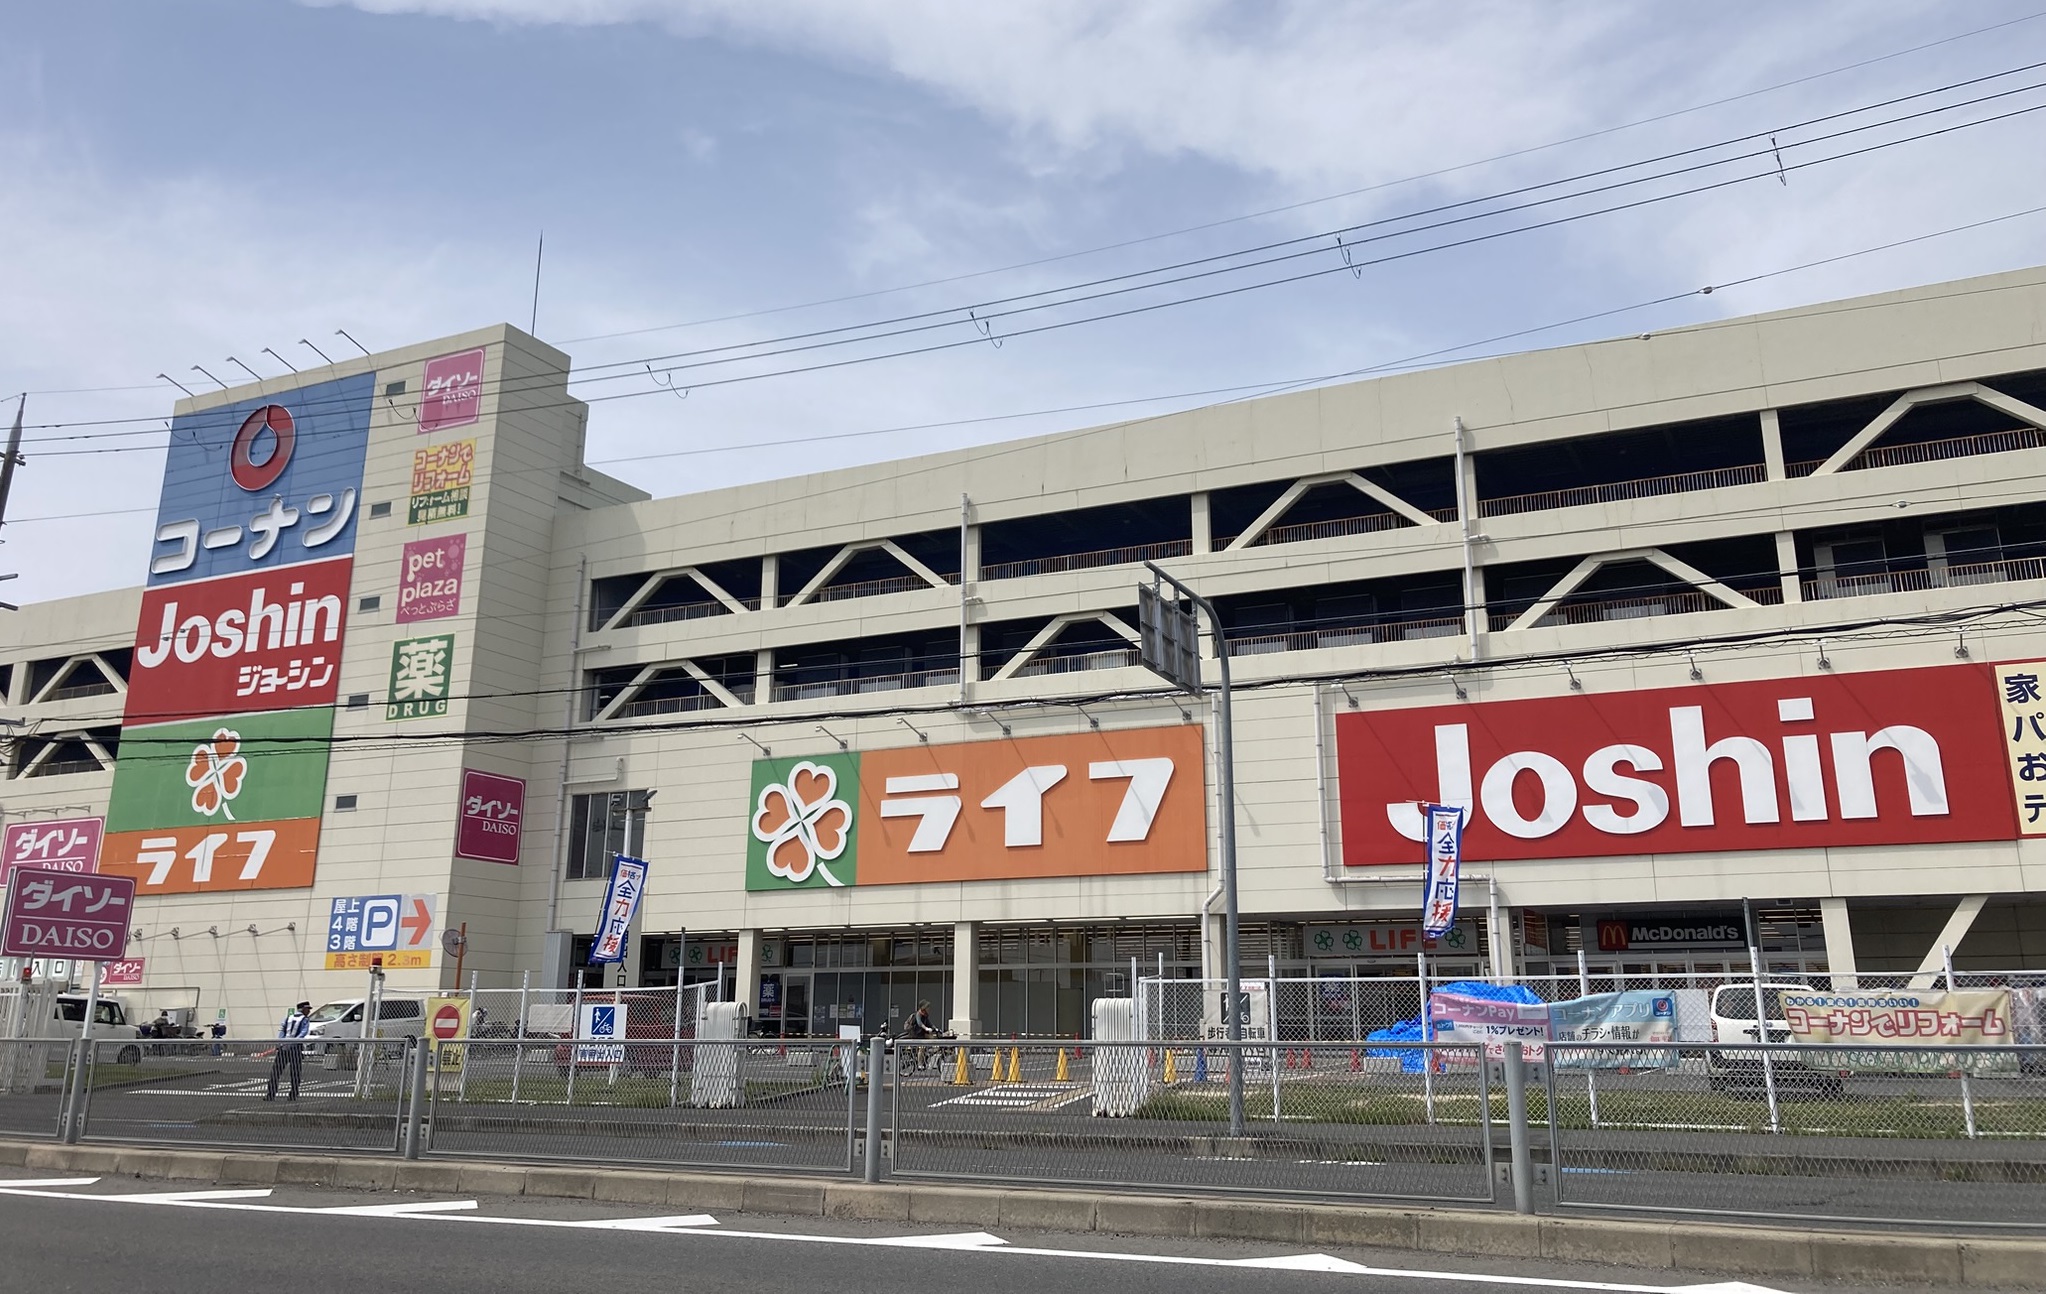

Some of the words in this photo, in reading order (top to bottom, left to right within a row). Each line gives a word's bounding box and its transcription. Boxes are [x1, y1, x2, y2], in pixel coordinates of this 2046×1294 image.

[427, 371, 478, 396] ダイソー
[442, 389, 477, 405] DAISO
[415, 443, 474, 471] コーナンで
[412, 464, 471, 494] リフォーム
[150, 486, 356, 575] コーナン
[406, 548, 446, 583] pet
[400, 578, 458, 606] plaza
[137, 581, 342, 669] Joshin
[236, 656, 334, 697] ジョーシン
[394, 639, 448, 701] 薬
[388, 699, 447, 718] DRUG
[1386, 697, 1950, 843] Joshin
[466, 795, 518, 819] ダイソー
[880, 757, 1175, 852] ライフ
[482, 821, 517, 835] DAISO
[15, 828, 88, 860] ダイソー
[137, 830, 276, 885] ライフ
[1431, 831, 1456, 923] 全力応援
[21, 880, 125, 913] ダイソー
[333, 899, 361, 914] 屋上
[331, 916, 359, 932] 4階
[602, 879, 636, 954] 全力応援
[19, 923, 114, 949] DAISO
[329, 934, 357, 950] 3階
[1631, 925, 1739, 941] McDonald's
[113, 962, 141, 974] ダイソー
[707, 946, 738, 963] LIF
[1434, 1002, 1515, 1021] コーナンPay
[1553, 1002, 1650, 1021] コーナンアプリ
[1786, 1008, 2005, 1038] コーナンでリフォーム
[1486, 1025, 1544, 1036] 1%プレゼント!
